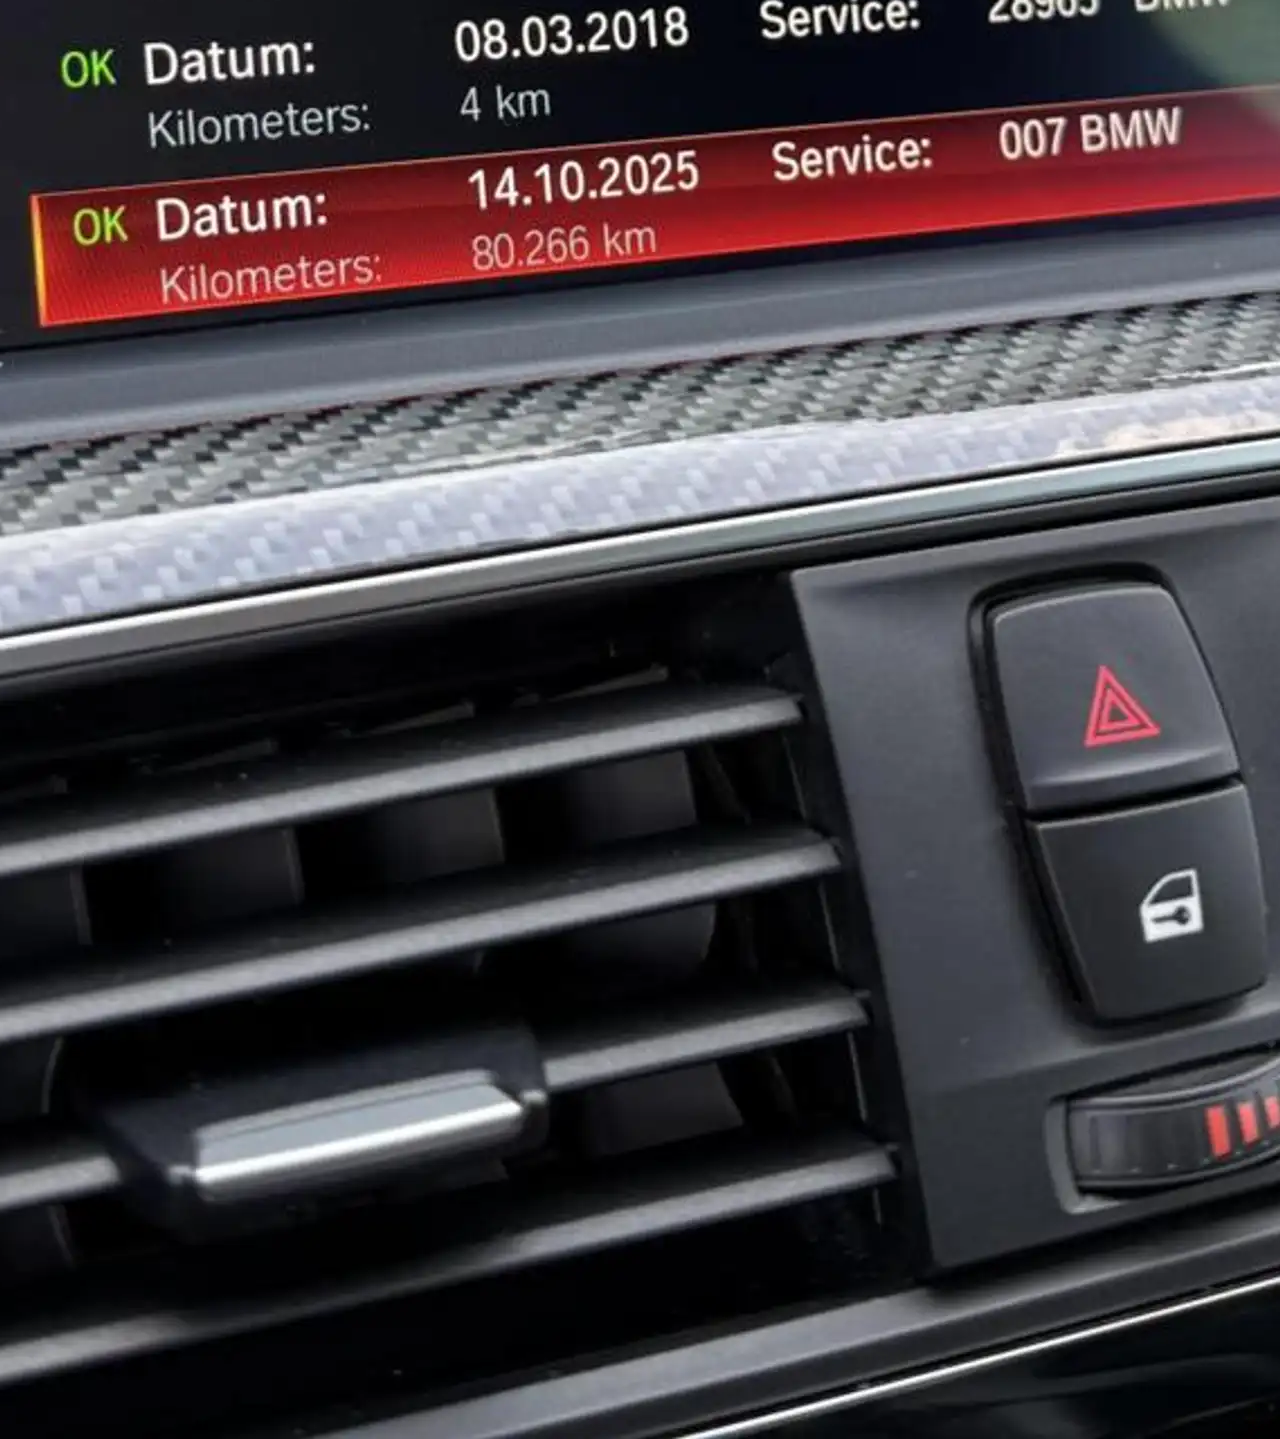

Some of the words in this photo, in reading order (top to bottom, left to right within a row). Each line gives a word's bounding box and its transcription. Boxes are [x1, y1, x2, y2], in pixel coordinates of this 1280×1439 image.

[61, 48, 116, 88] OK
[144, 41, 315, 85] Datum:
[455, 5, 689, 62] 08.03.2018
[148, 102, 370, 149] Kilometers:
[460, 86, 482, 122] 4
[495, 84, 551, 119] km
[73, 205, 128, 246] OK
[156, 193, 327, 241] Datum:
[465, 146, 699, 210] 14.10.2025
[772, 134, 932, 181] Service:
[999, 116, 1067, 160] 007
[1080, 106, 1181, 153] BMW
[161, 254, 382, 304] Kilometers:
[471, 224, 590, 272] 80.266
[603, 223, 657, 258] km
